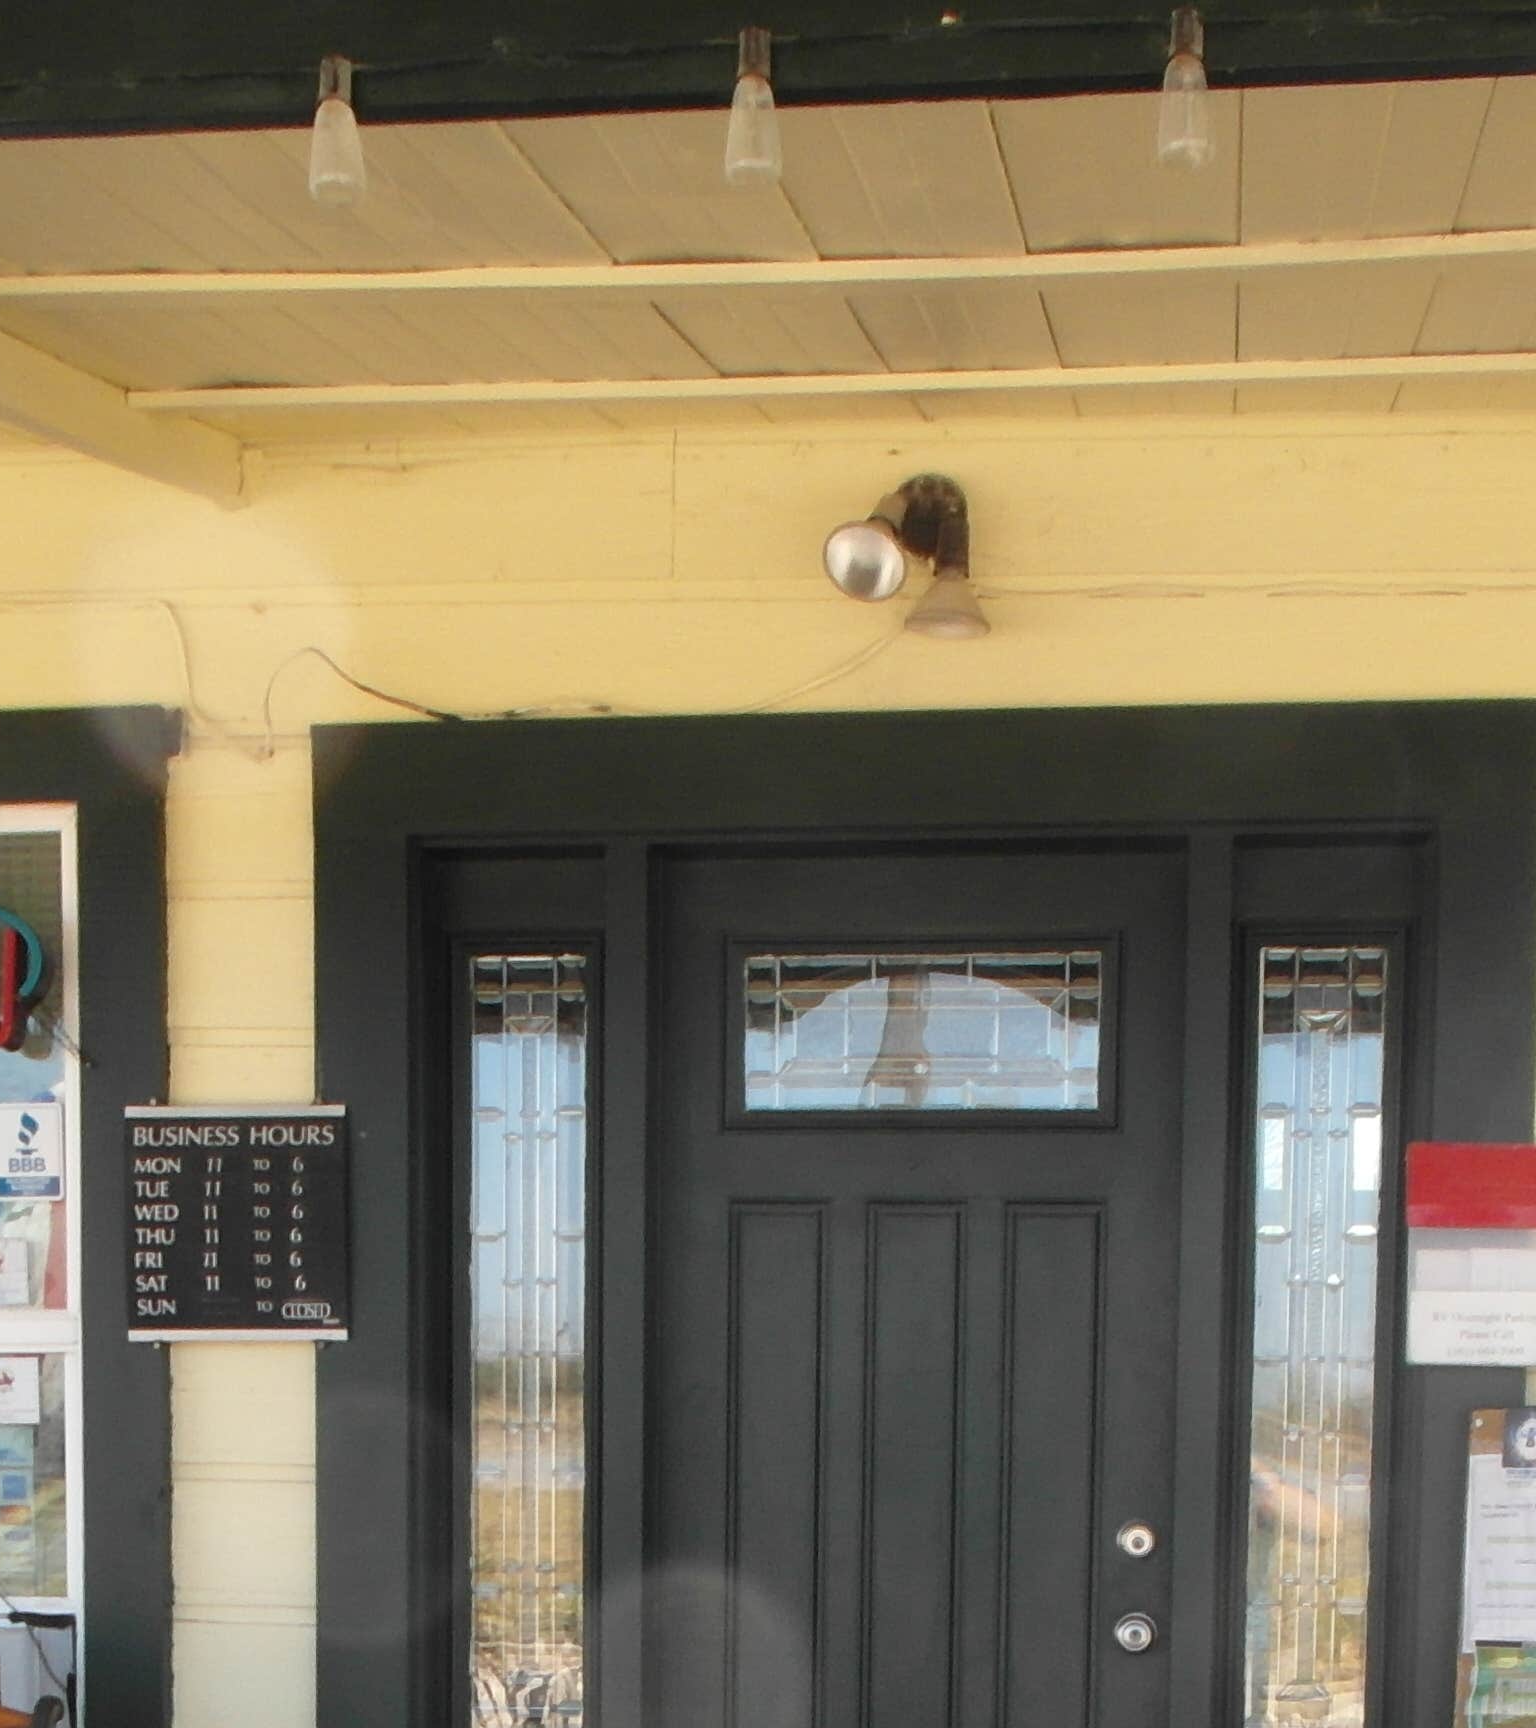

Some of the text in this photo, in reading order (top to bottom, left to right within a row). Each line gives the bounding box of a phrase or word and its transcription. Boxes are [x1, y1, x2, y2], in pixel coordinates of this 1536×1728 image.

[133, 1125, 335, 1147] BUSINESS HOURS
[8, 1157, 46, 1173] BBB
[134, 1157, 304, 1174] MON 11 TO 6
[135, 1180, 303, 1198] TUE 11 TO 6
[134, 1204, 303, 1221] WED 11 TO 6
[135, 1227, 302, 1245] THU 11 TO 6
[134, 1251, 302, 1268] FRI 11 TO 6
[135, 1275, 306, 1293] SAT 11 TO 6
[137, 1299, 331, 1320] SUN TO CLOSED
